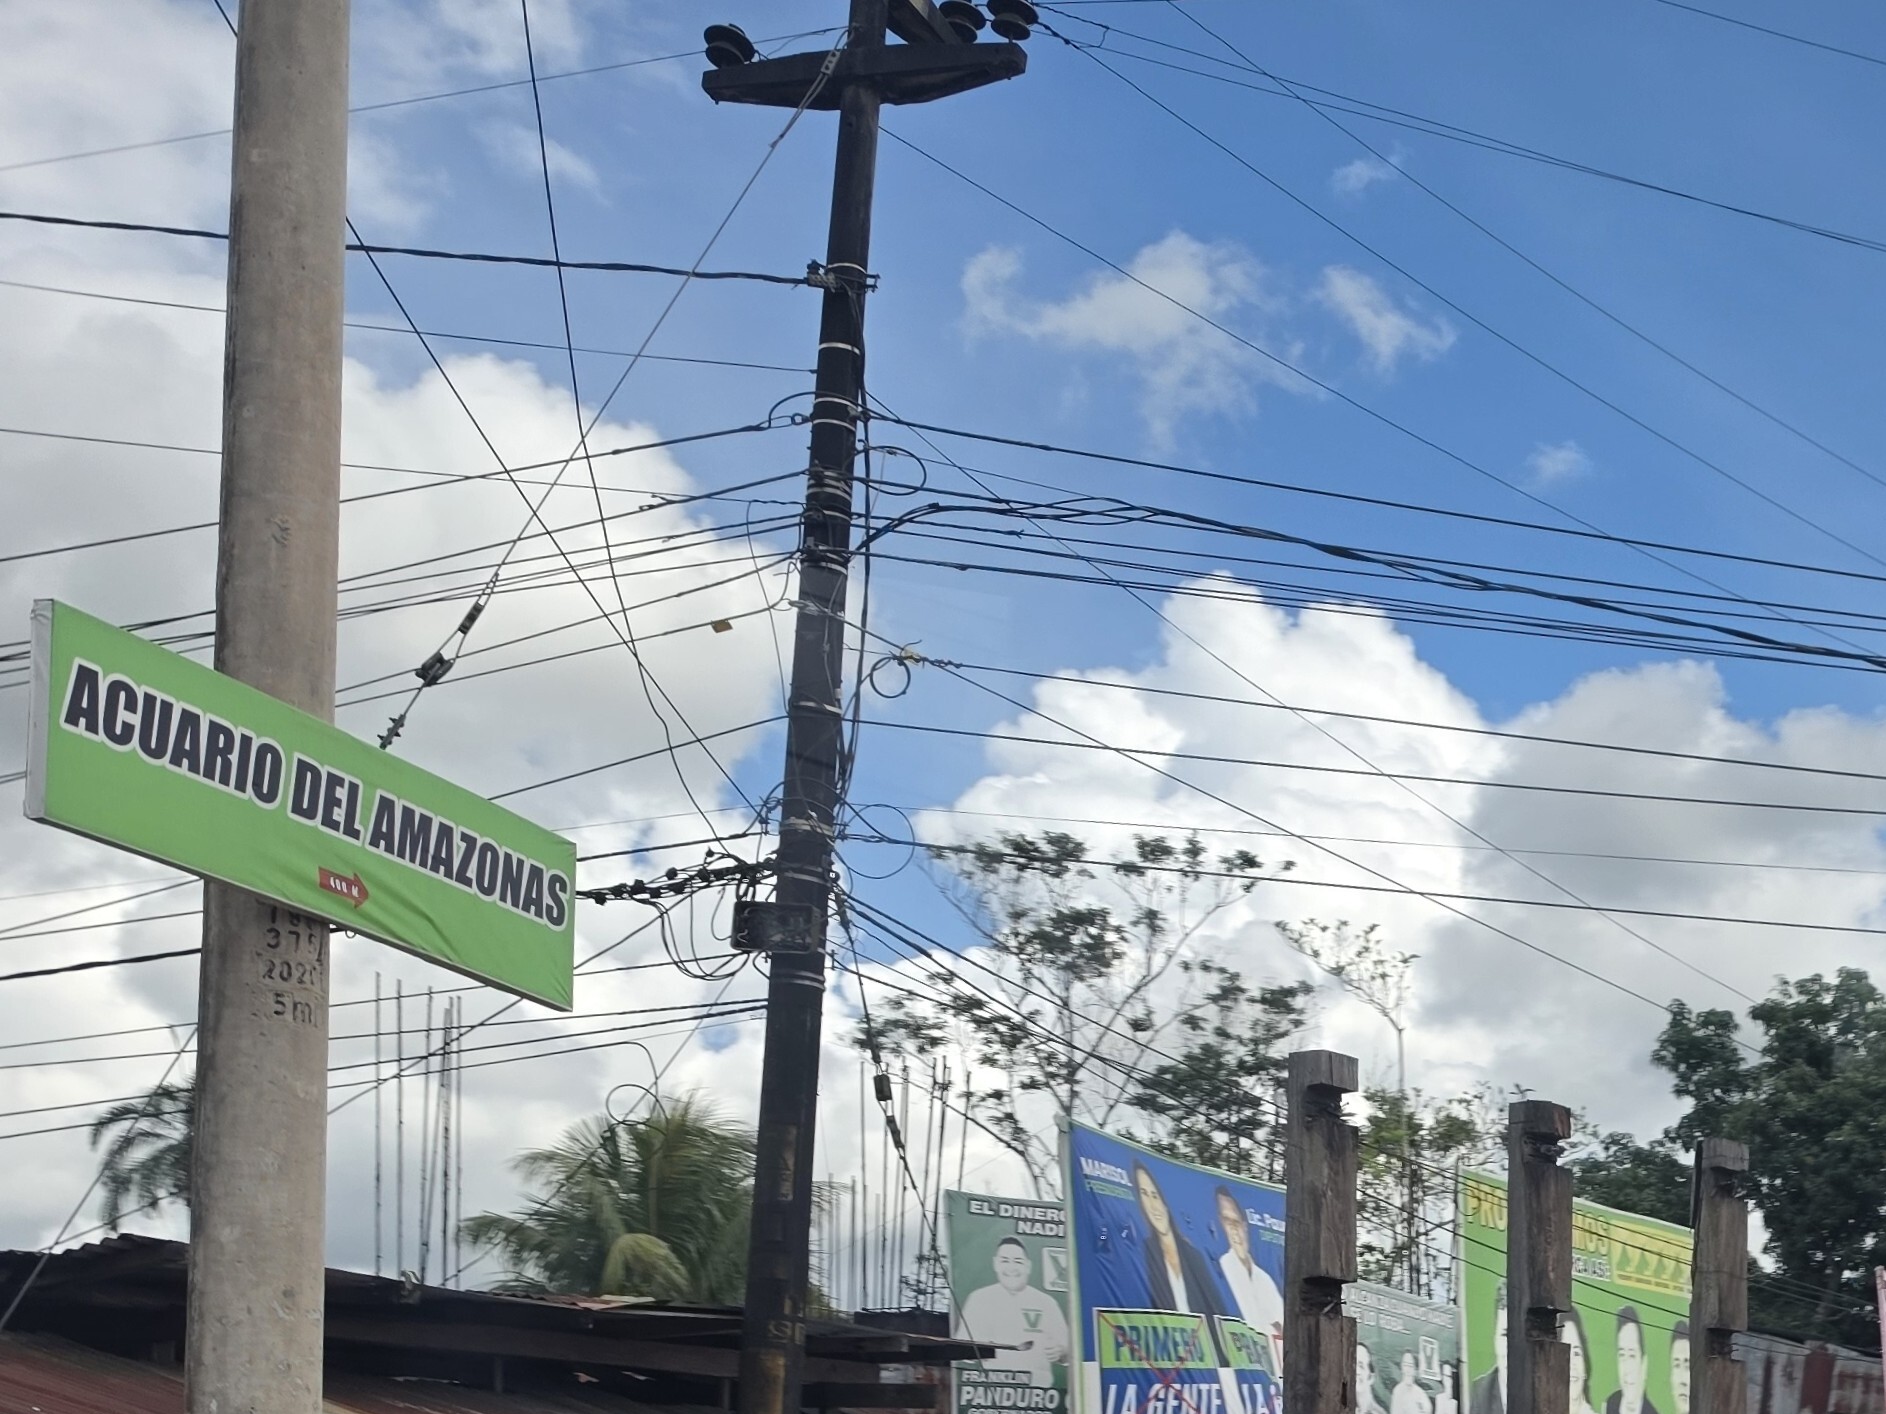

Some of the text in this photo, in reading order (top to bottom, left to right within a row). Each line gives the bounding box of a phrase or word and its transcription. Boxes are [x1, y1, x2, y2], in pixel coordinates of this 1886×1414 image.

[62, 660, 571, 930] ACUARIO DEL AMAZONAS
[329, 876, 348, 894] 400
[968, 1200, 996, 1216] EL
[1114, 1325, 1206, 1363] PRIMERO
[960, 1385, 1060, 1410] PANDURO
